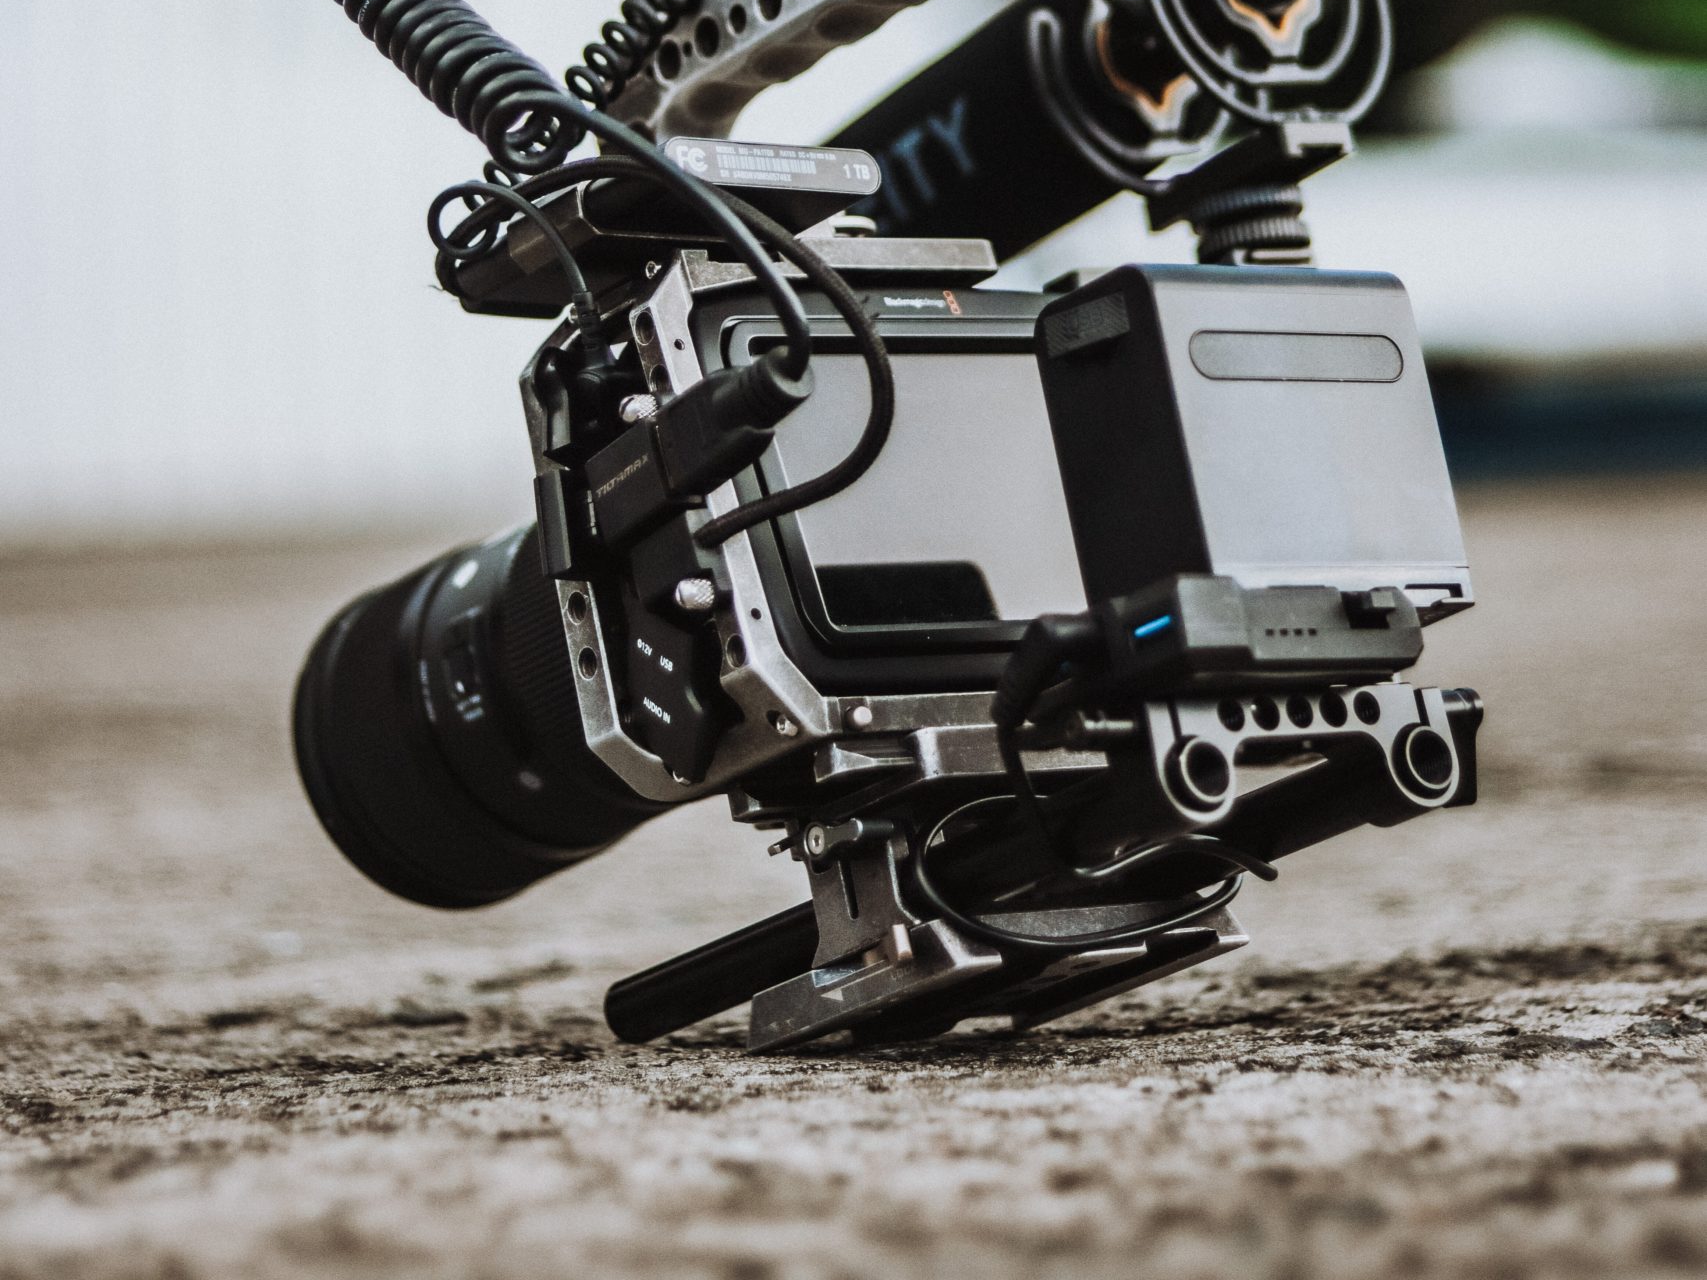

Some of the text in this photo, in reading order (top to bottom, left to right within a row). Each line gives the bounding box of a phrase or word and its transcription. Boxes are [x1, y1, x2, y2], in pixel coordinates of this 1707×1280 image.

[843, 164, 870, 180] 1 TB
[660, 655, 673, 672] USB
[643, 696, 671, 724] AUDIO IN
